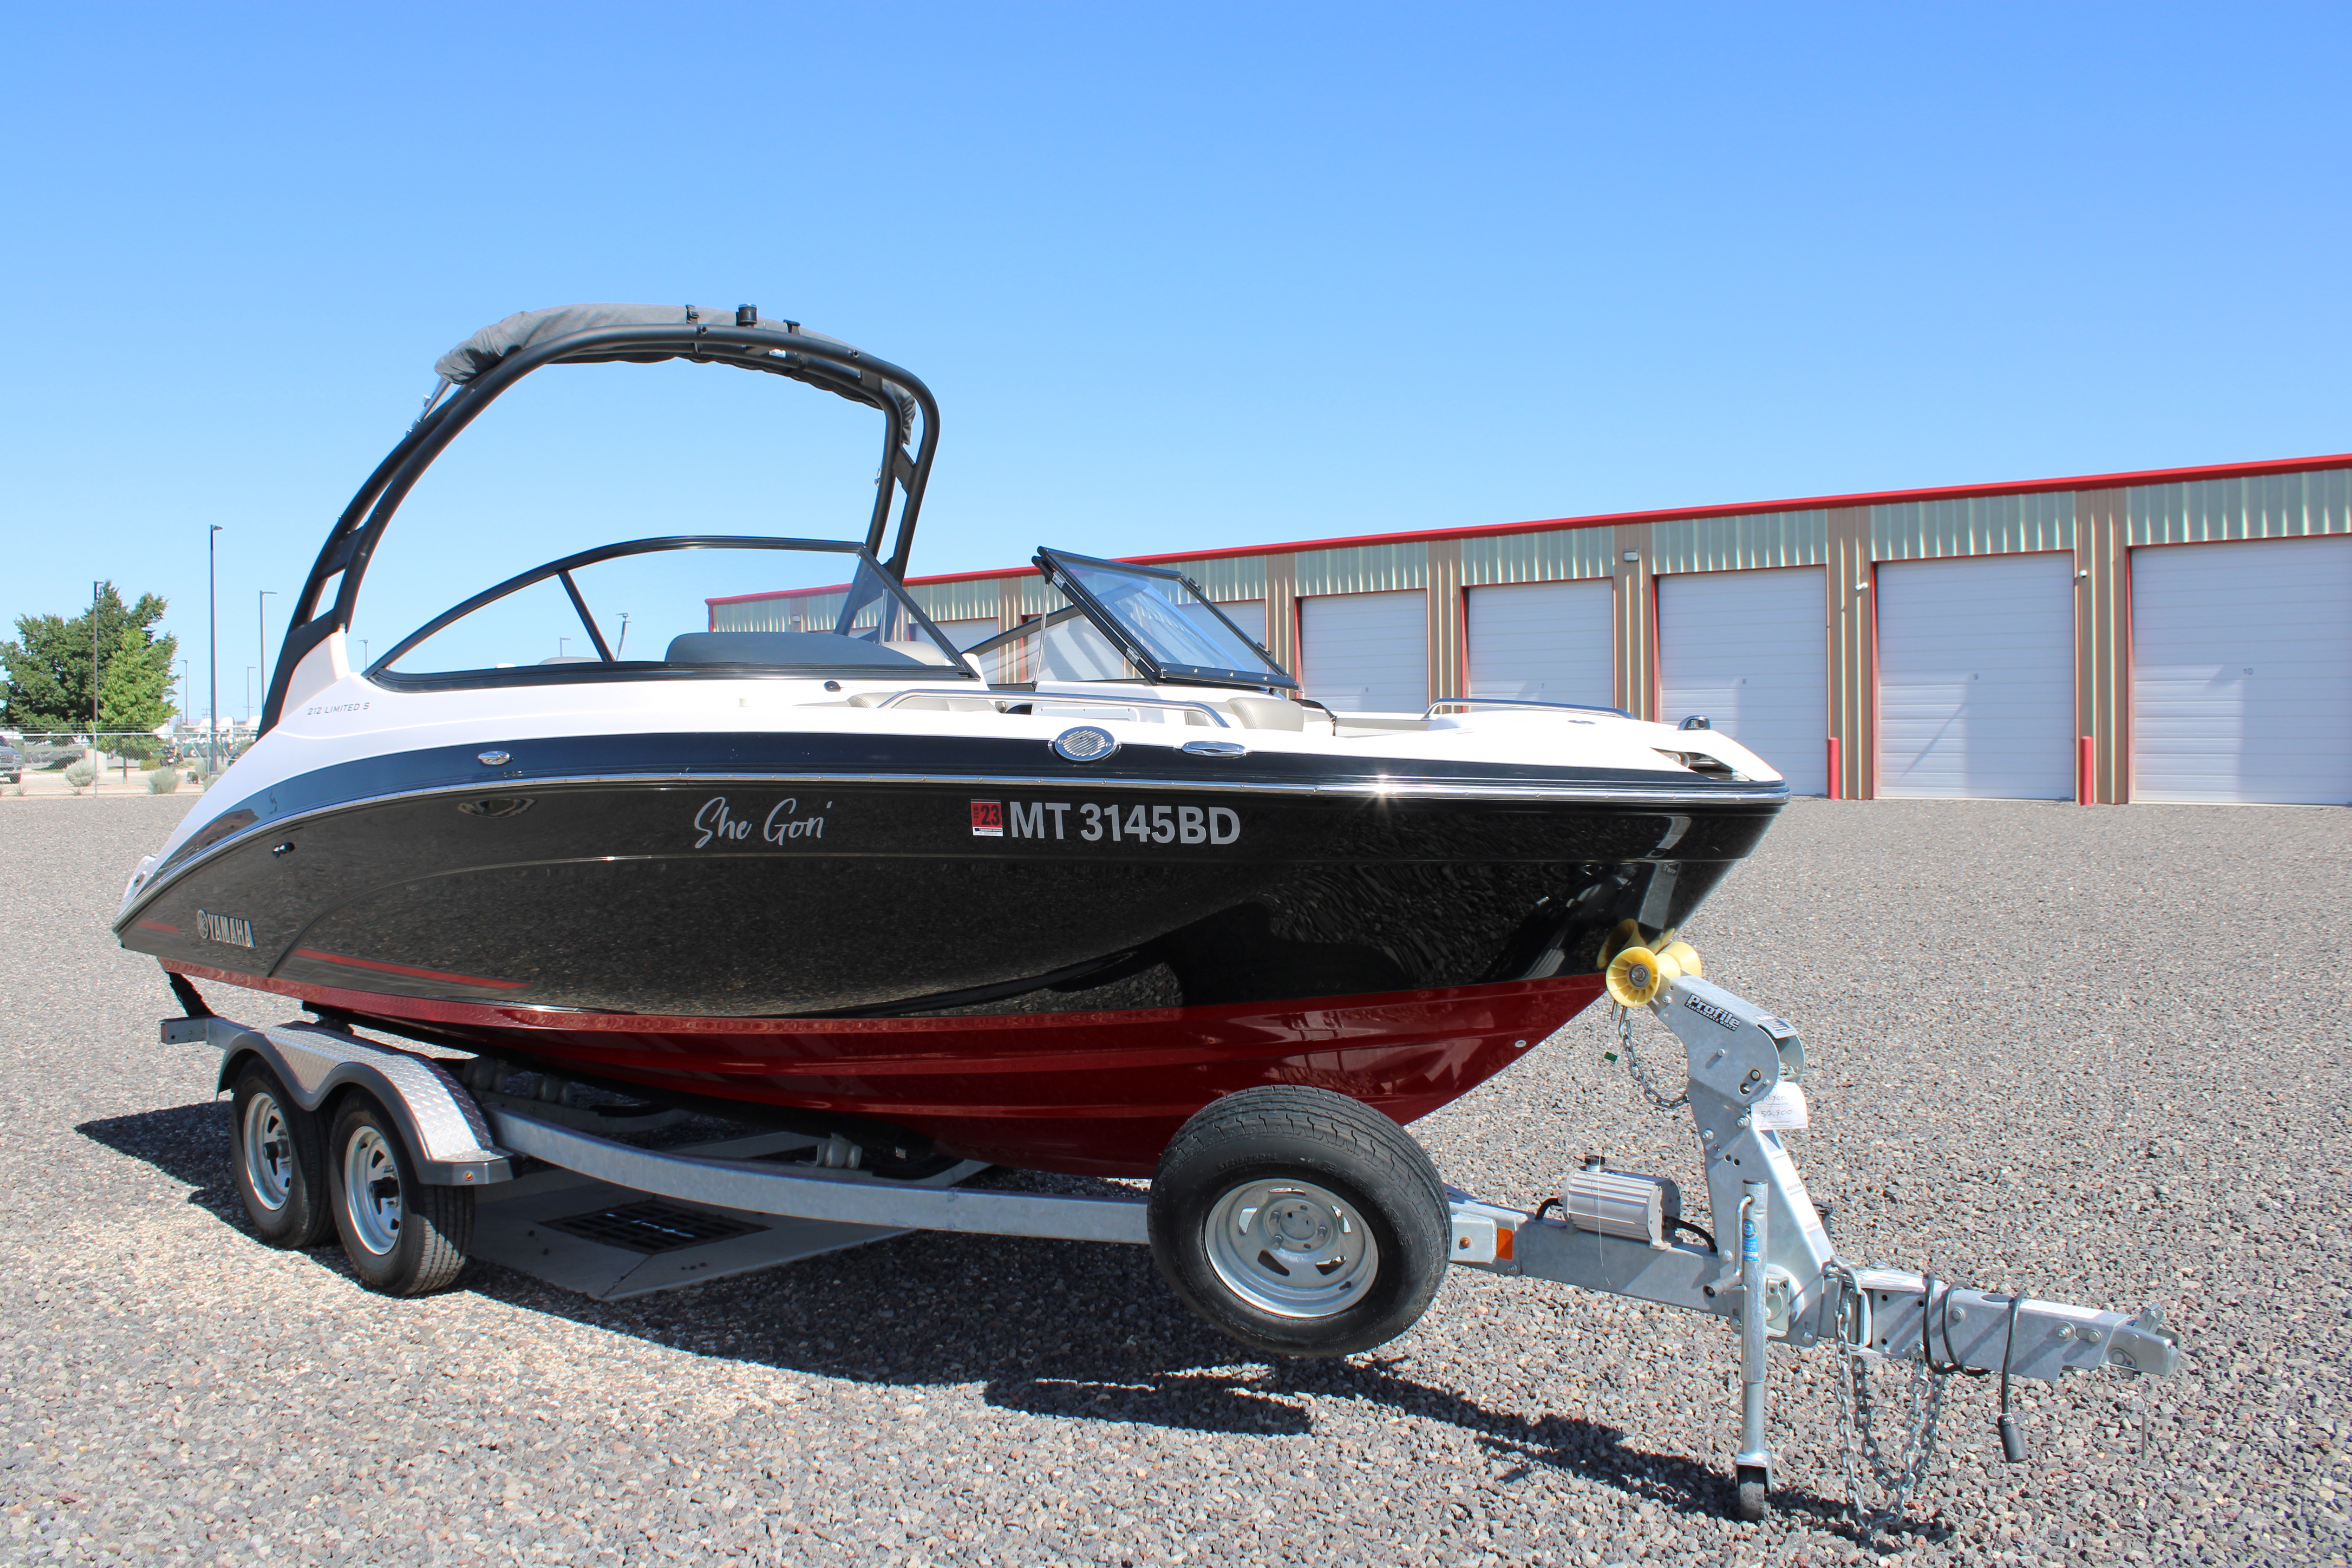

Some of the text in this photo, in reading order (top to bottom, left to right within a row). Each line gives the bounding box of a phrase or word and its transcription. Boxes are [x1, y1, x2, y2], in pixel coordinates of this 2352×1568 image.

[308, 707, 322, 715] 212
[325, 703, 360, 714] LIMITED
[694, 796, 753, 849] She
[981, 805, 1000, 826] 23
[1010, 801, 1240, 844] MT 3145BD
[207, 913, 255, 948] YAMAHA
[1685, 1002, 1720, 1023] PERFORMANCE
[1719, 1020, 1736, 1031] WINCH
[1687, 994, 1741, 1028] Profile
[1318, 1160, 1413, 1246] CARLISLE
